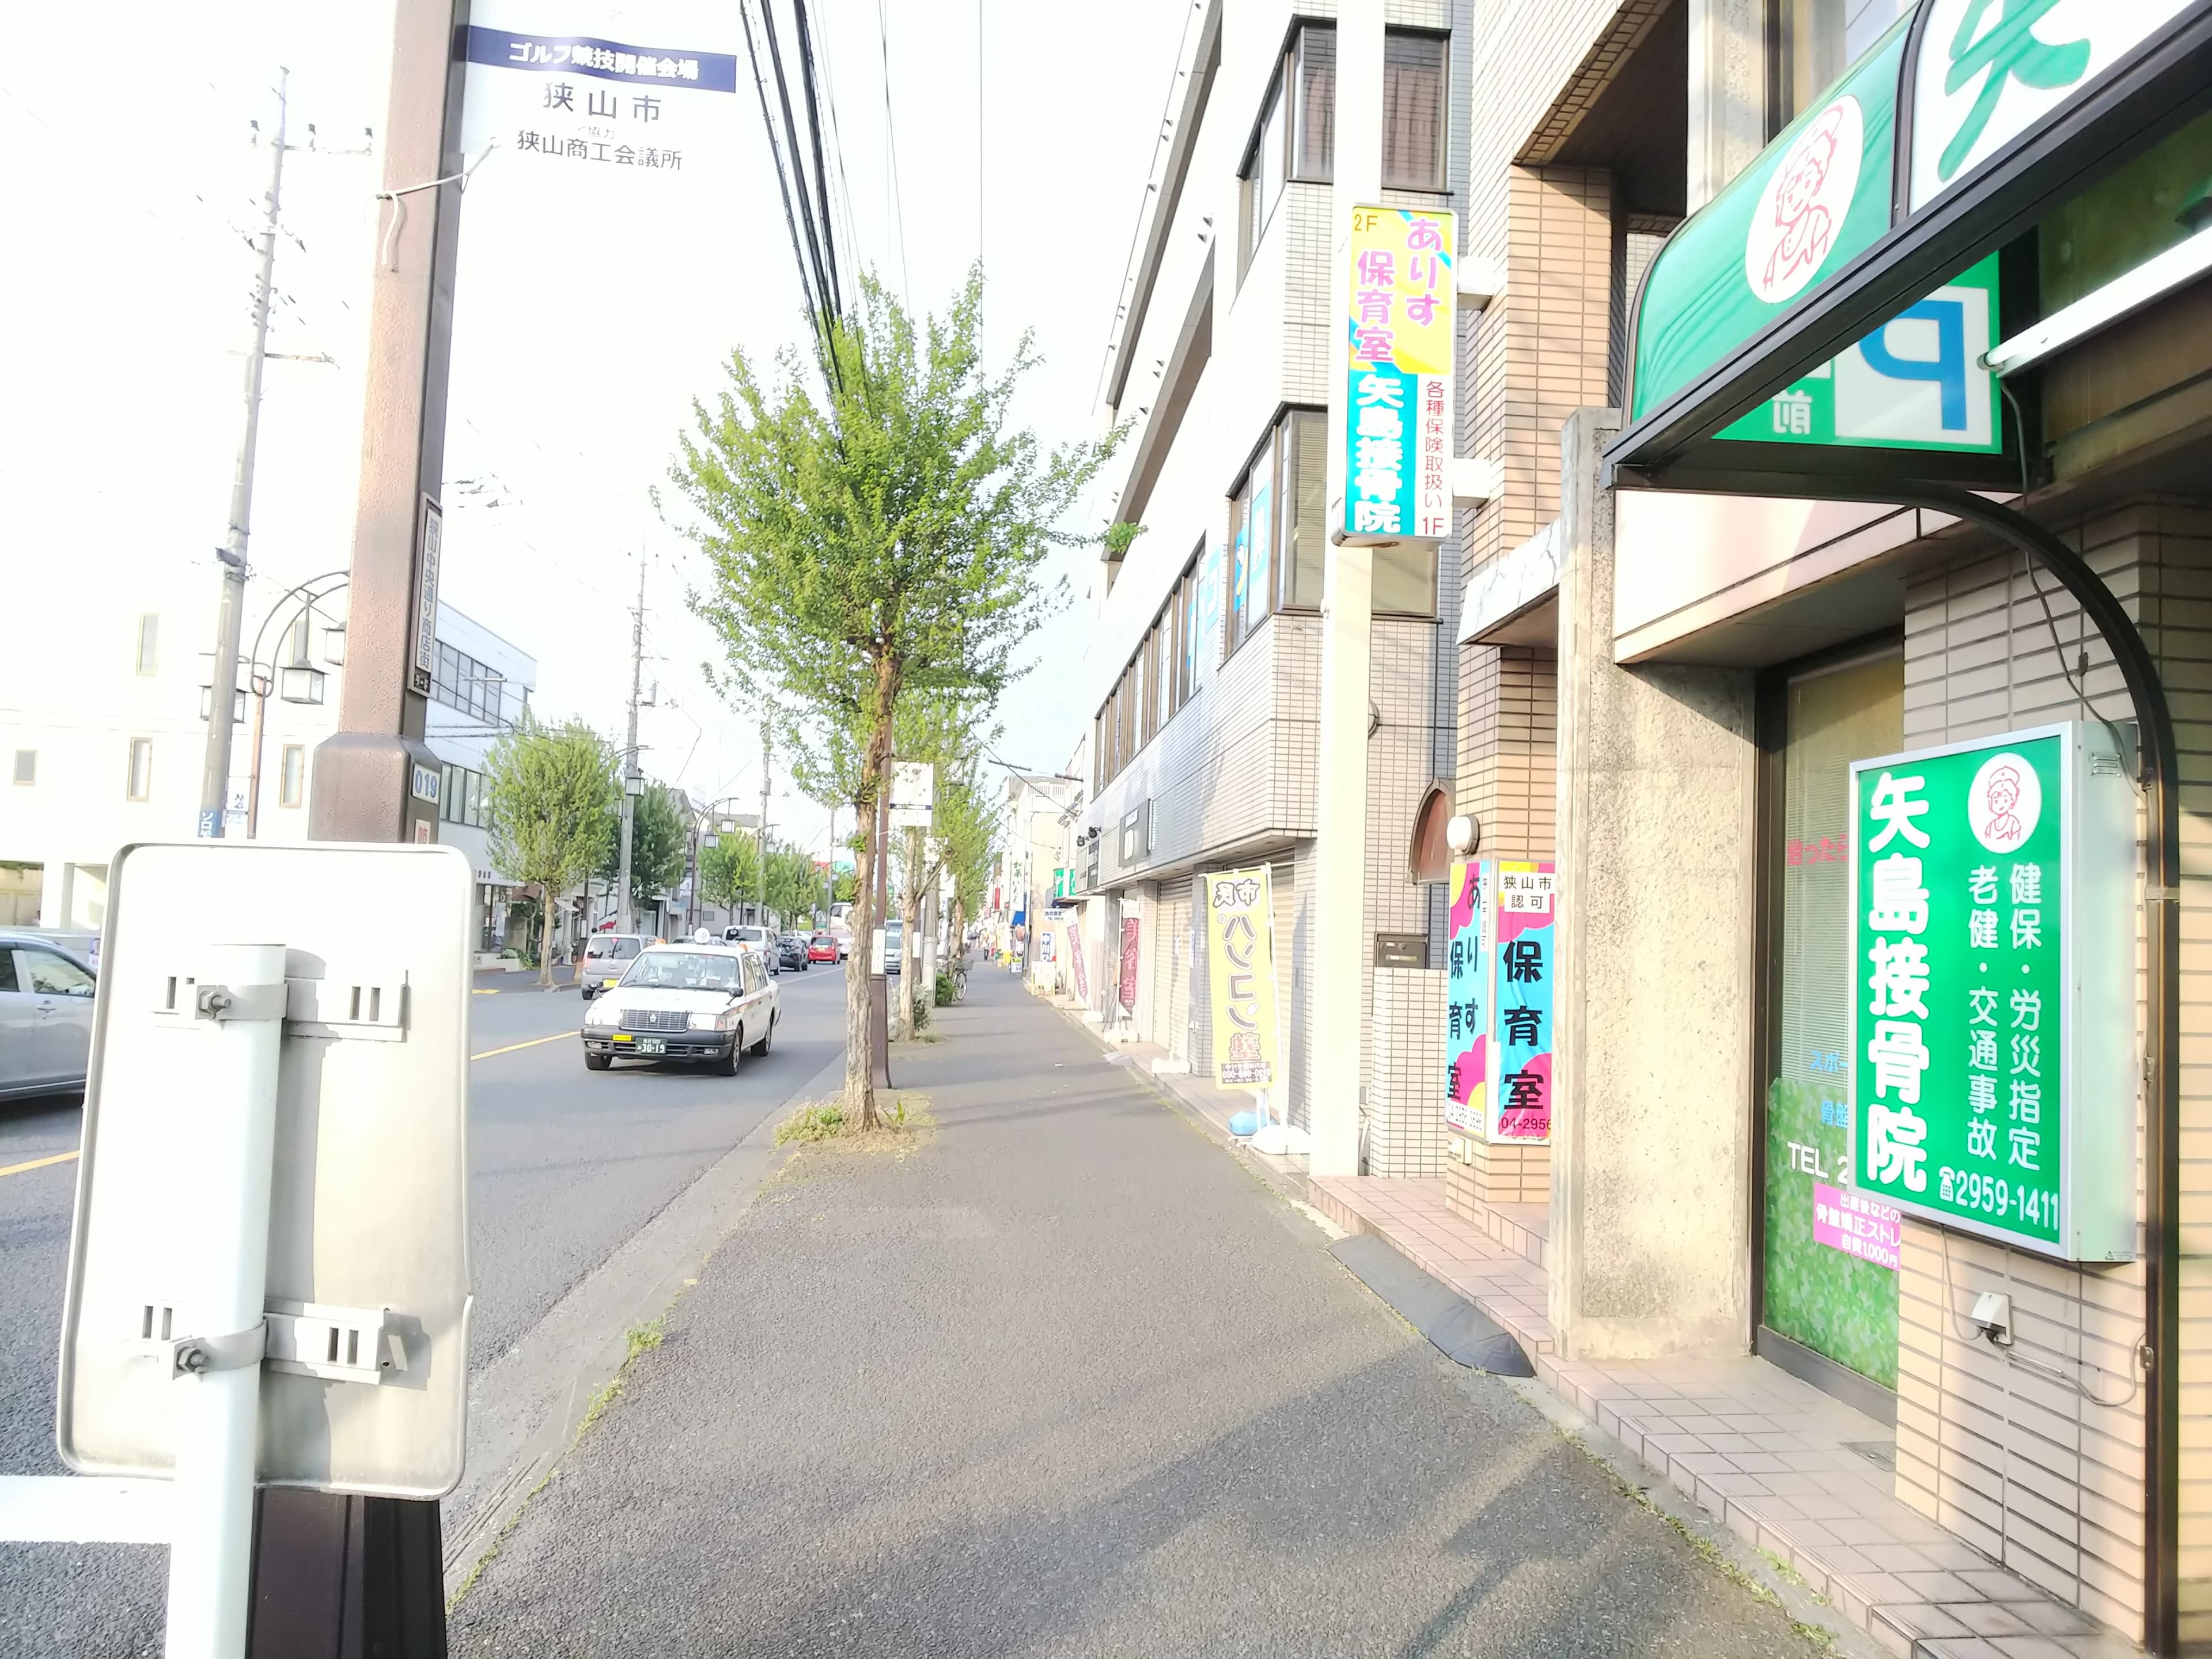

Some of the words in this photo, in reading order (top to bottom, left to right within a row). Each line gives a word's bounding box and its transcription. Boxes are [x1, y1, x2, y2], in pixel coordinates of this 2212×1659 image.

[509, 42, 699, 80] ゴルフ競技開催会場
[543, 82, 661, 122] 狭山市
[517, 130, 683, 171] 狭山商工会議所
[1354, 214, 1378, 232] 2F
[1407, 218, 1442, 327] ありす
[1355, 250, 1395, 363] 保育室
[1354, 374, 1404, 533] 矢島接骨院
[1425, 381, 1445, 507] 各種保険取扱い
[1423, 517, 1445, 535] 1F
[419, 519, 438, 669] 狭山中央通り商店街
[415, 770, 437, 798] 019
[1503, 876, 1552, 891] 狭山市
[1511, 895, 1544, 910] 認可
[1465, 874, 1481, 1036] ありす
[1866, 772, 1931, 1195] 矢島接骨院
[1448, 940, 1464, 1101] 保育室
[1503, 940, 1544, 1111] 保育室
[1967, 863, 1999, 1161] 老健・交通事故
[2008, 862, 2043, 1171] 健保・労災指定
[1821, 1100, 1848, 1128] 骨盤
[1787, 1141, 1829, 1180] TEL
[1840, 1192, 1900, 1224] 出産後などの
[1955, 1169, 2058, 1231] 2959-1411
